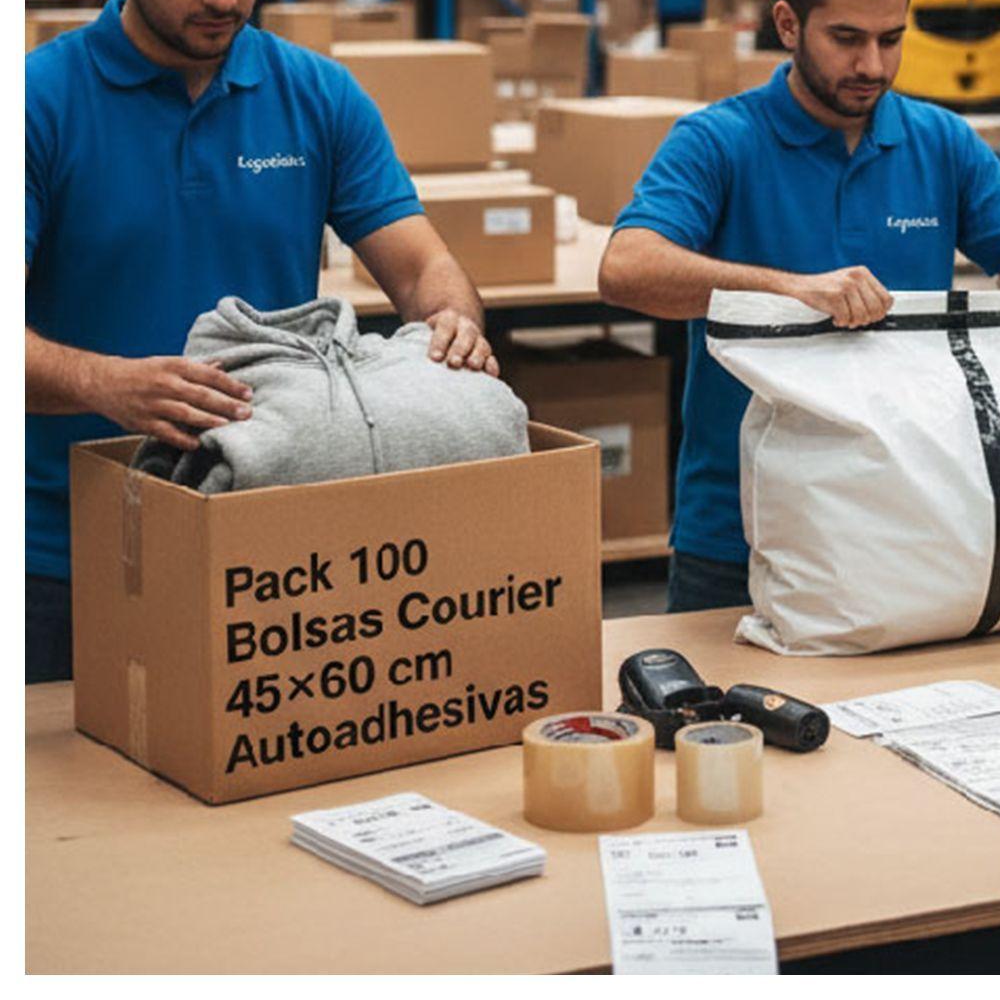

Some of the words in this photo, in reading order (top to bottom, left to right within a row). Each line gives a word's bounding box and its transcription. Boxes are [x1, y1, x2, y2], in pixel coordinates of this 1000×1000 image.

[225, 553, 334, 607] Pack
[350, 538, 428, 584] 100
[226, 611, 384, 663] Bolsas
[397, 575, 562, 630] Courier
[388, 648, 453, 686] cm
[224, 679, 549, 774] Autoadhesivas
